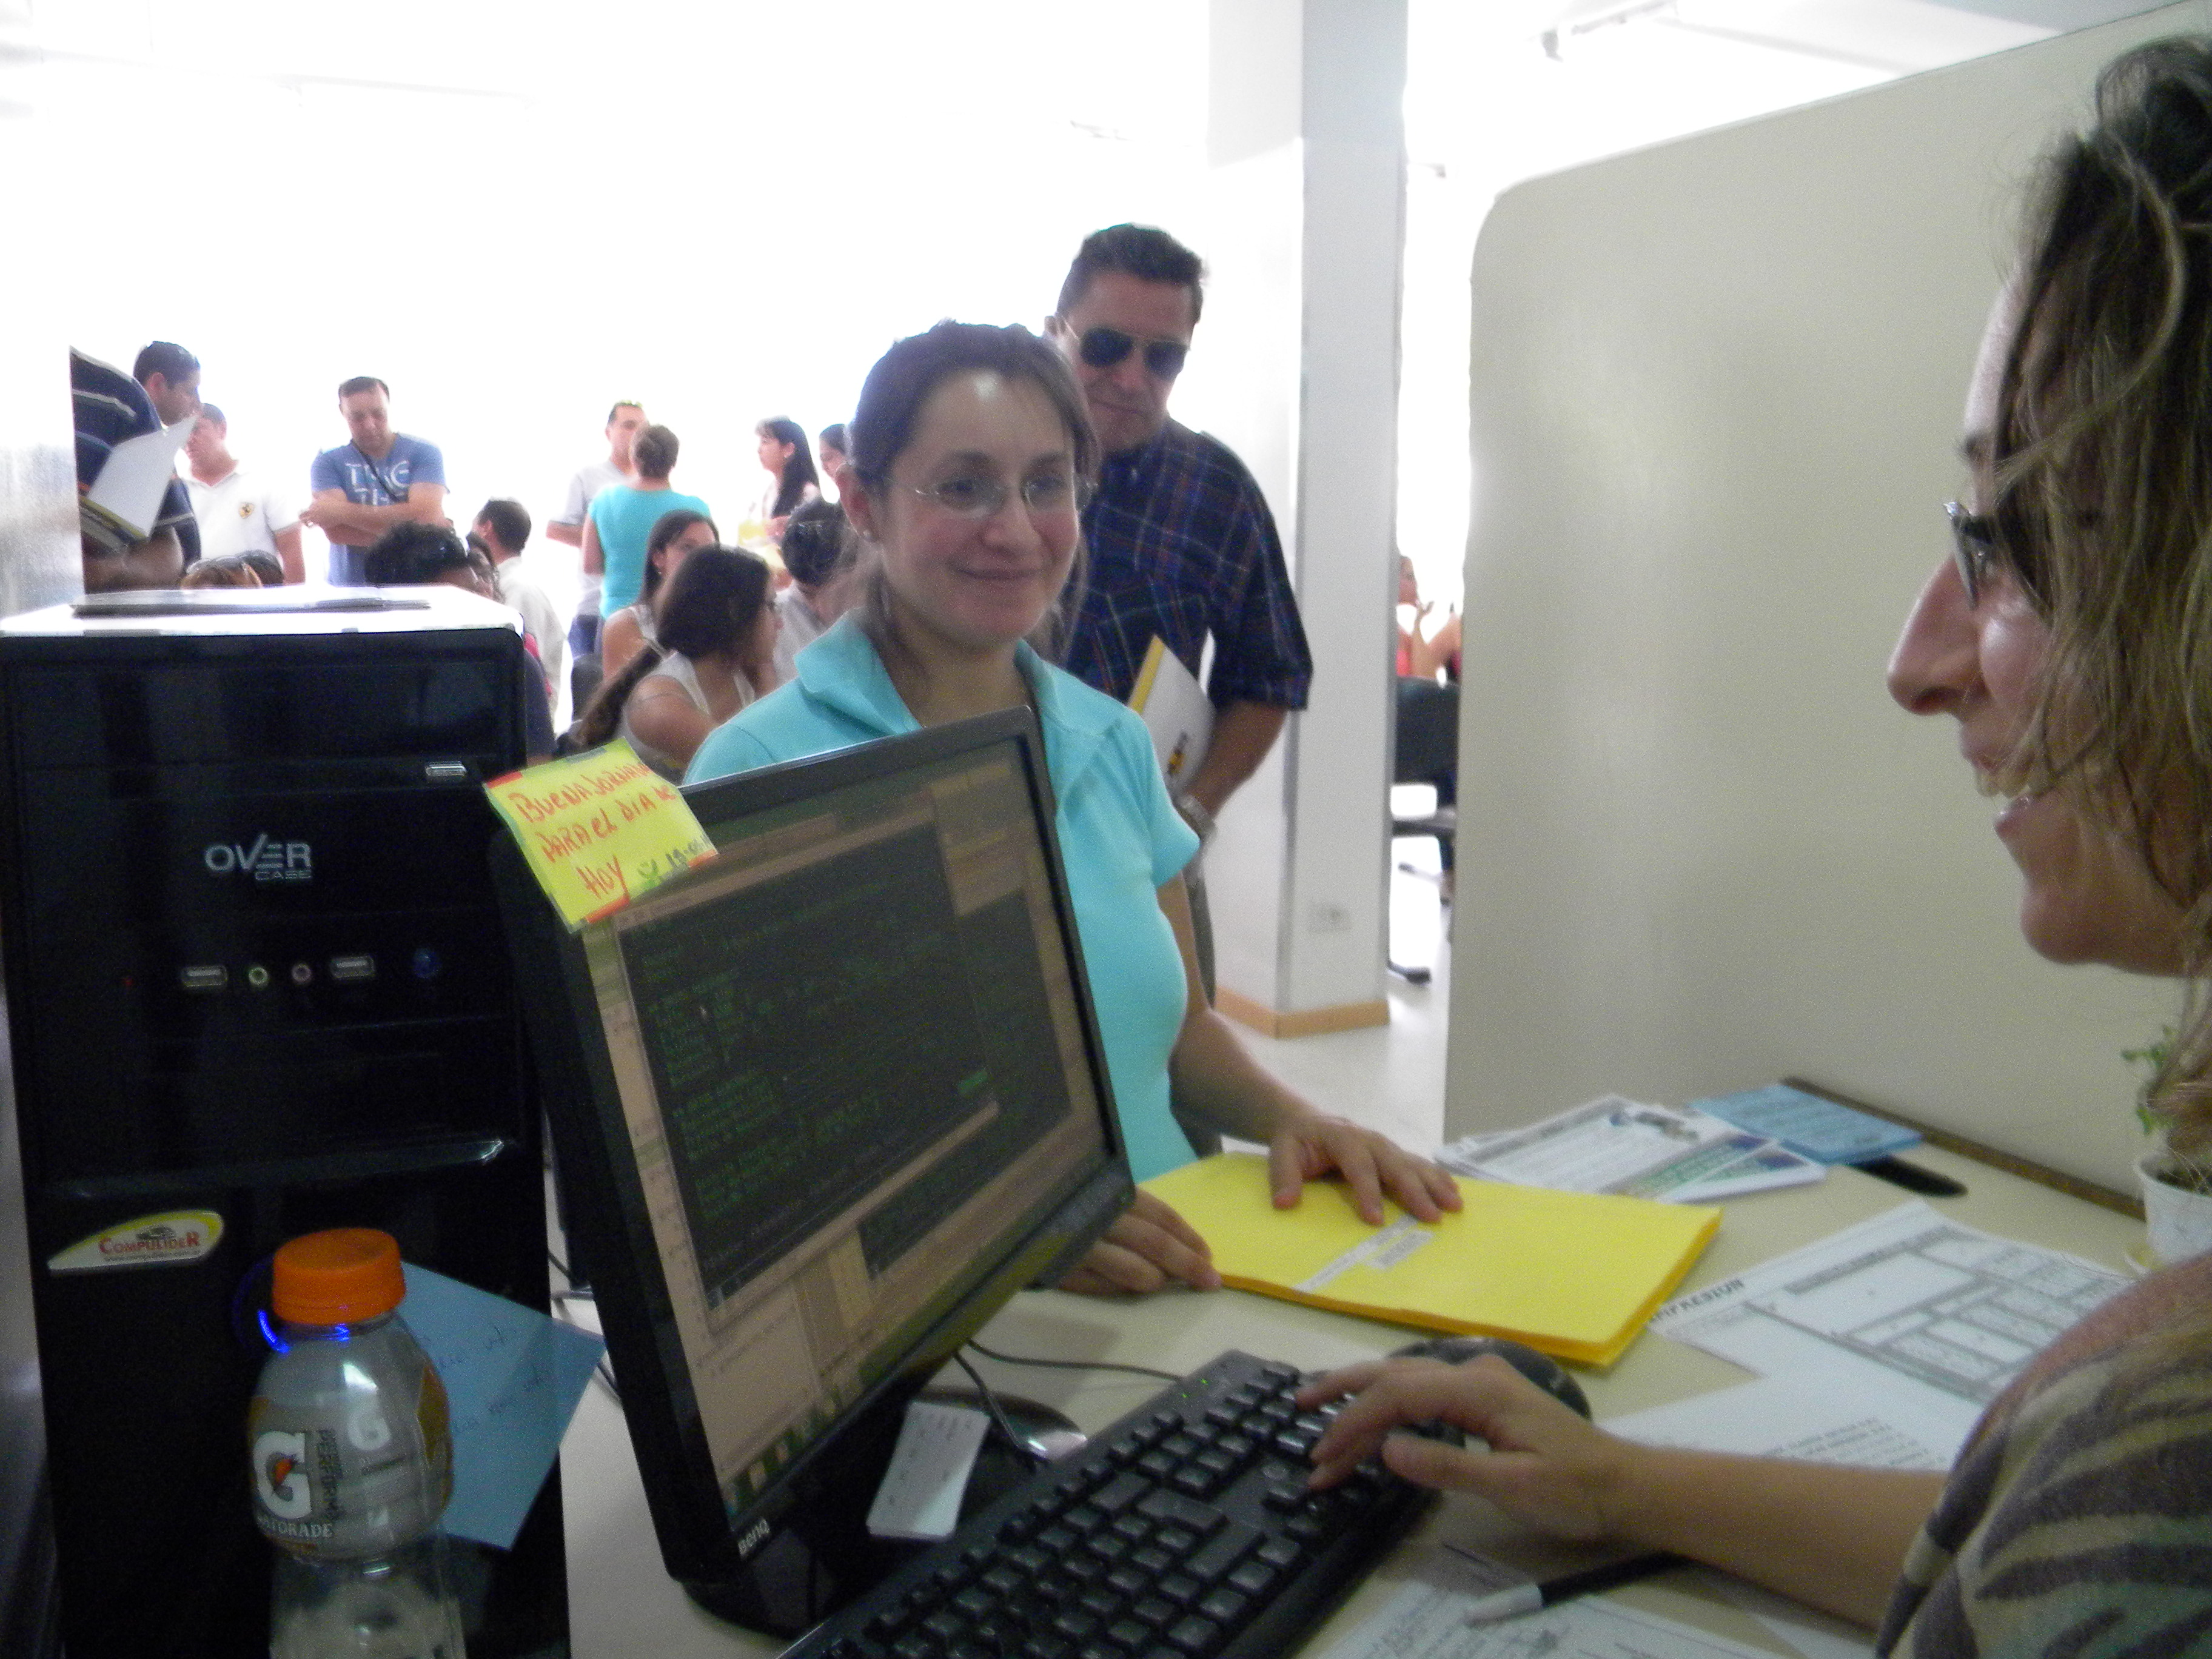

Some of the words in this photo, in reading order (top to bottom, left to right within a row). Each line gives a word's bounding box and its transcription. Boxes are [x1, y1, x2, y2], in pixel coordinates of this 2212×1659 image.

[205, 834, 312, 871] OVER
[255, 870, 312, 880] CASE
[575, 854, 630, 900] HOY
